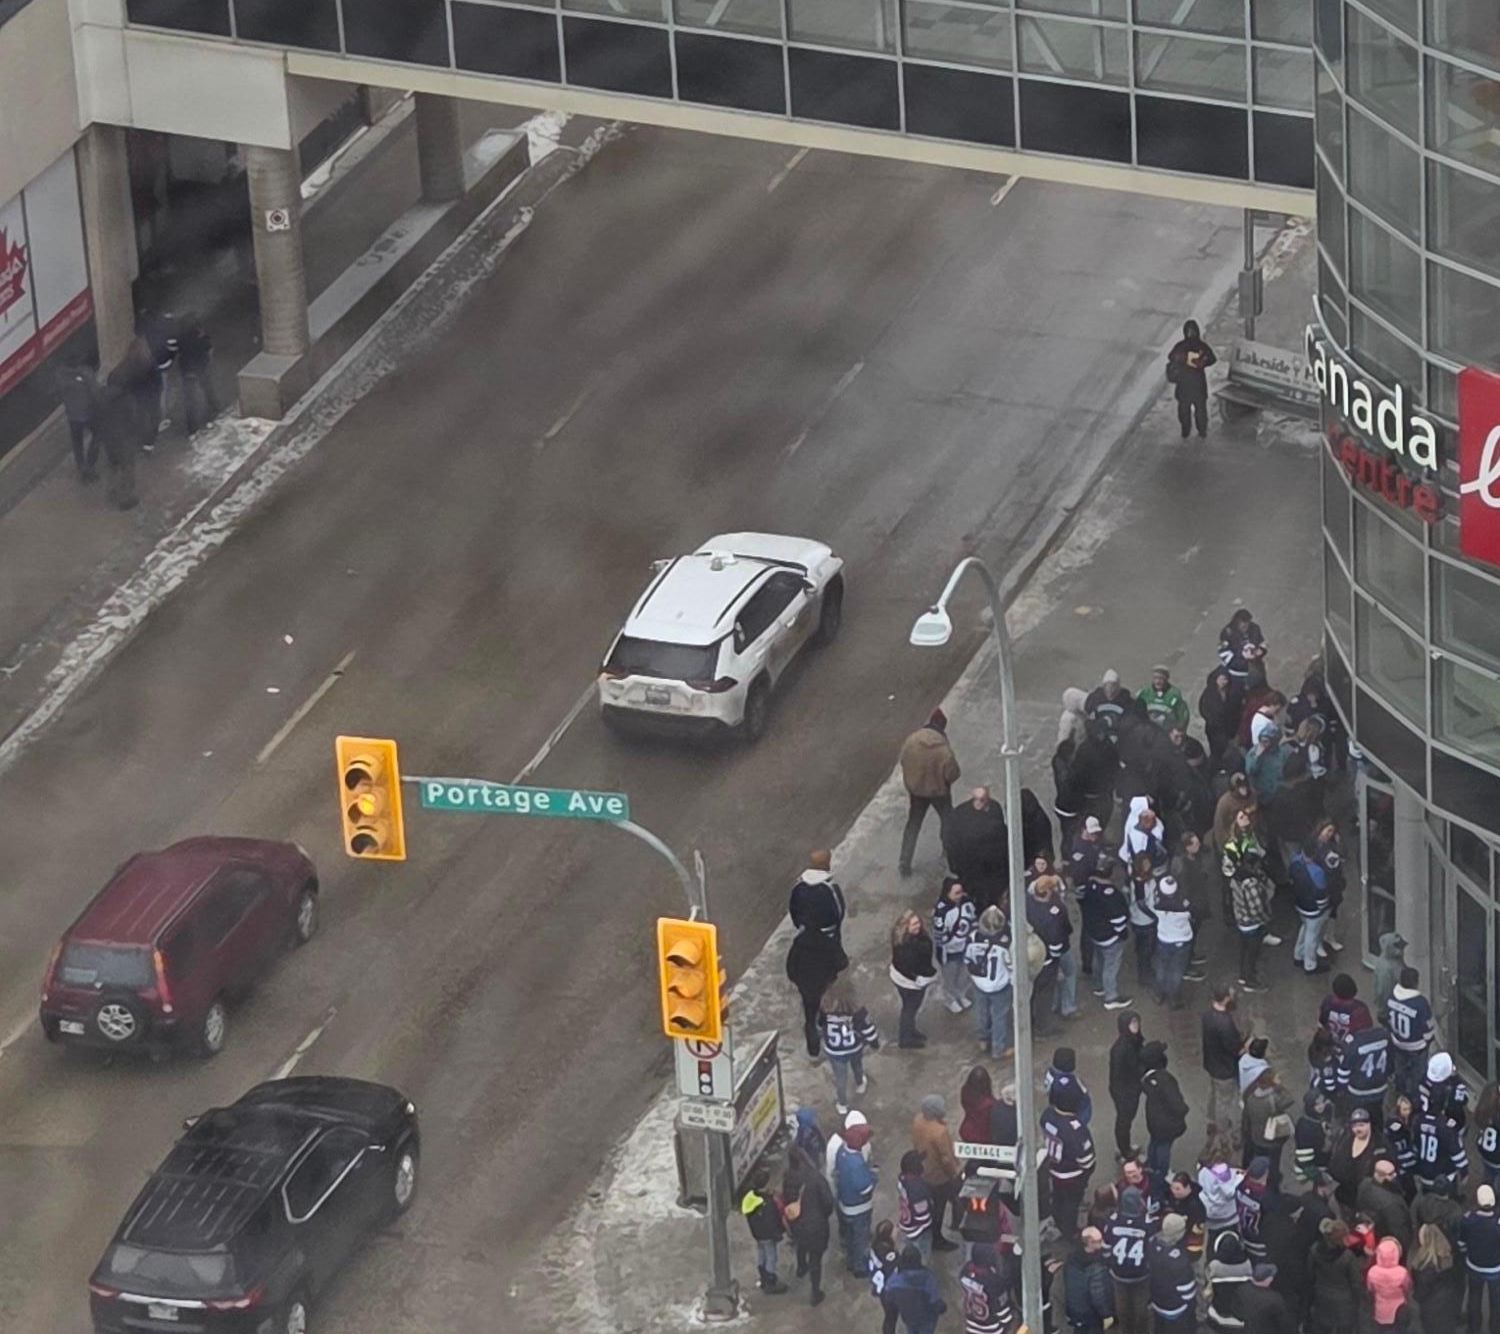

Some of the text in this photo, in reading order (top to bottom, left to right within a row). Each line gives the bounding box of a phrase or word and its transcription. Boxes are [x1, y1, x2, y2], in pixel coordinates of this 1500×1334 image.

[1326, 420, 1439, 524] centre
[427, 782, 624, 815] Portage Ave
[1359, 1049, 1388, 1079] 44
[1112, 1237, 1145, 1266] 44
